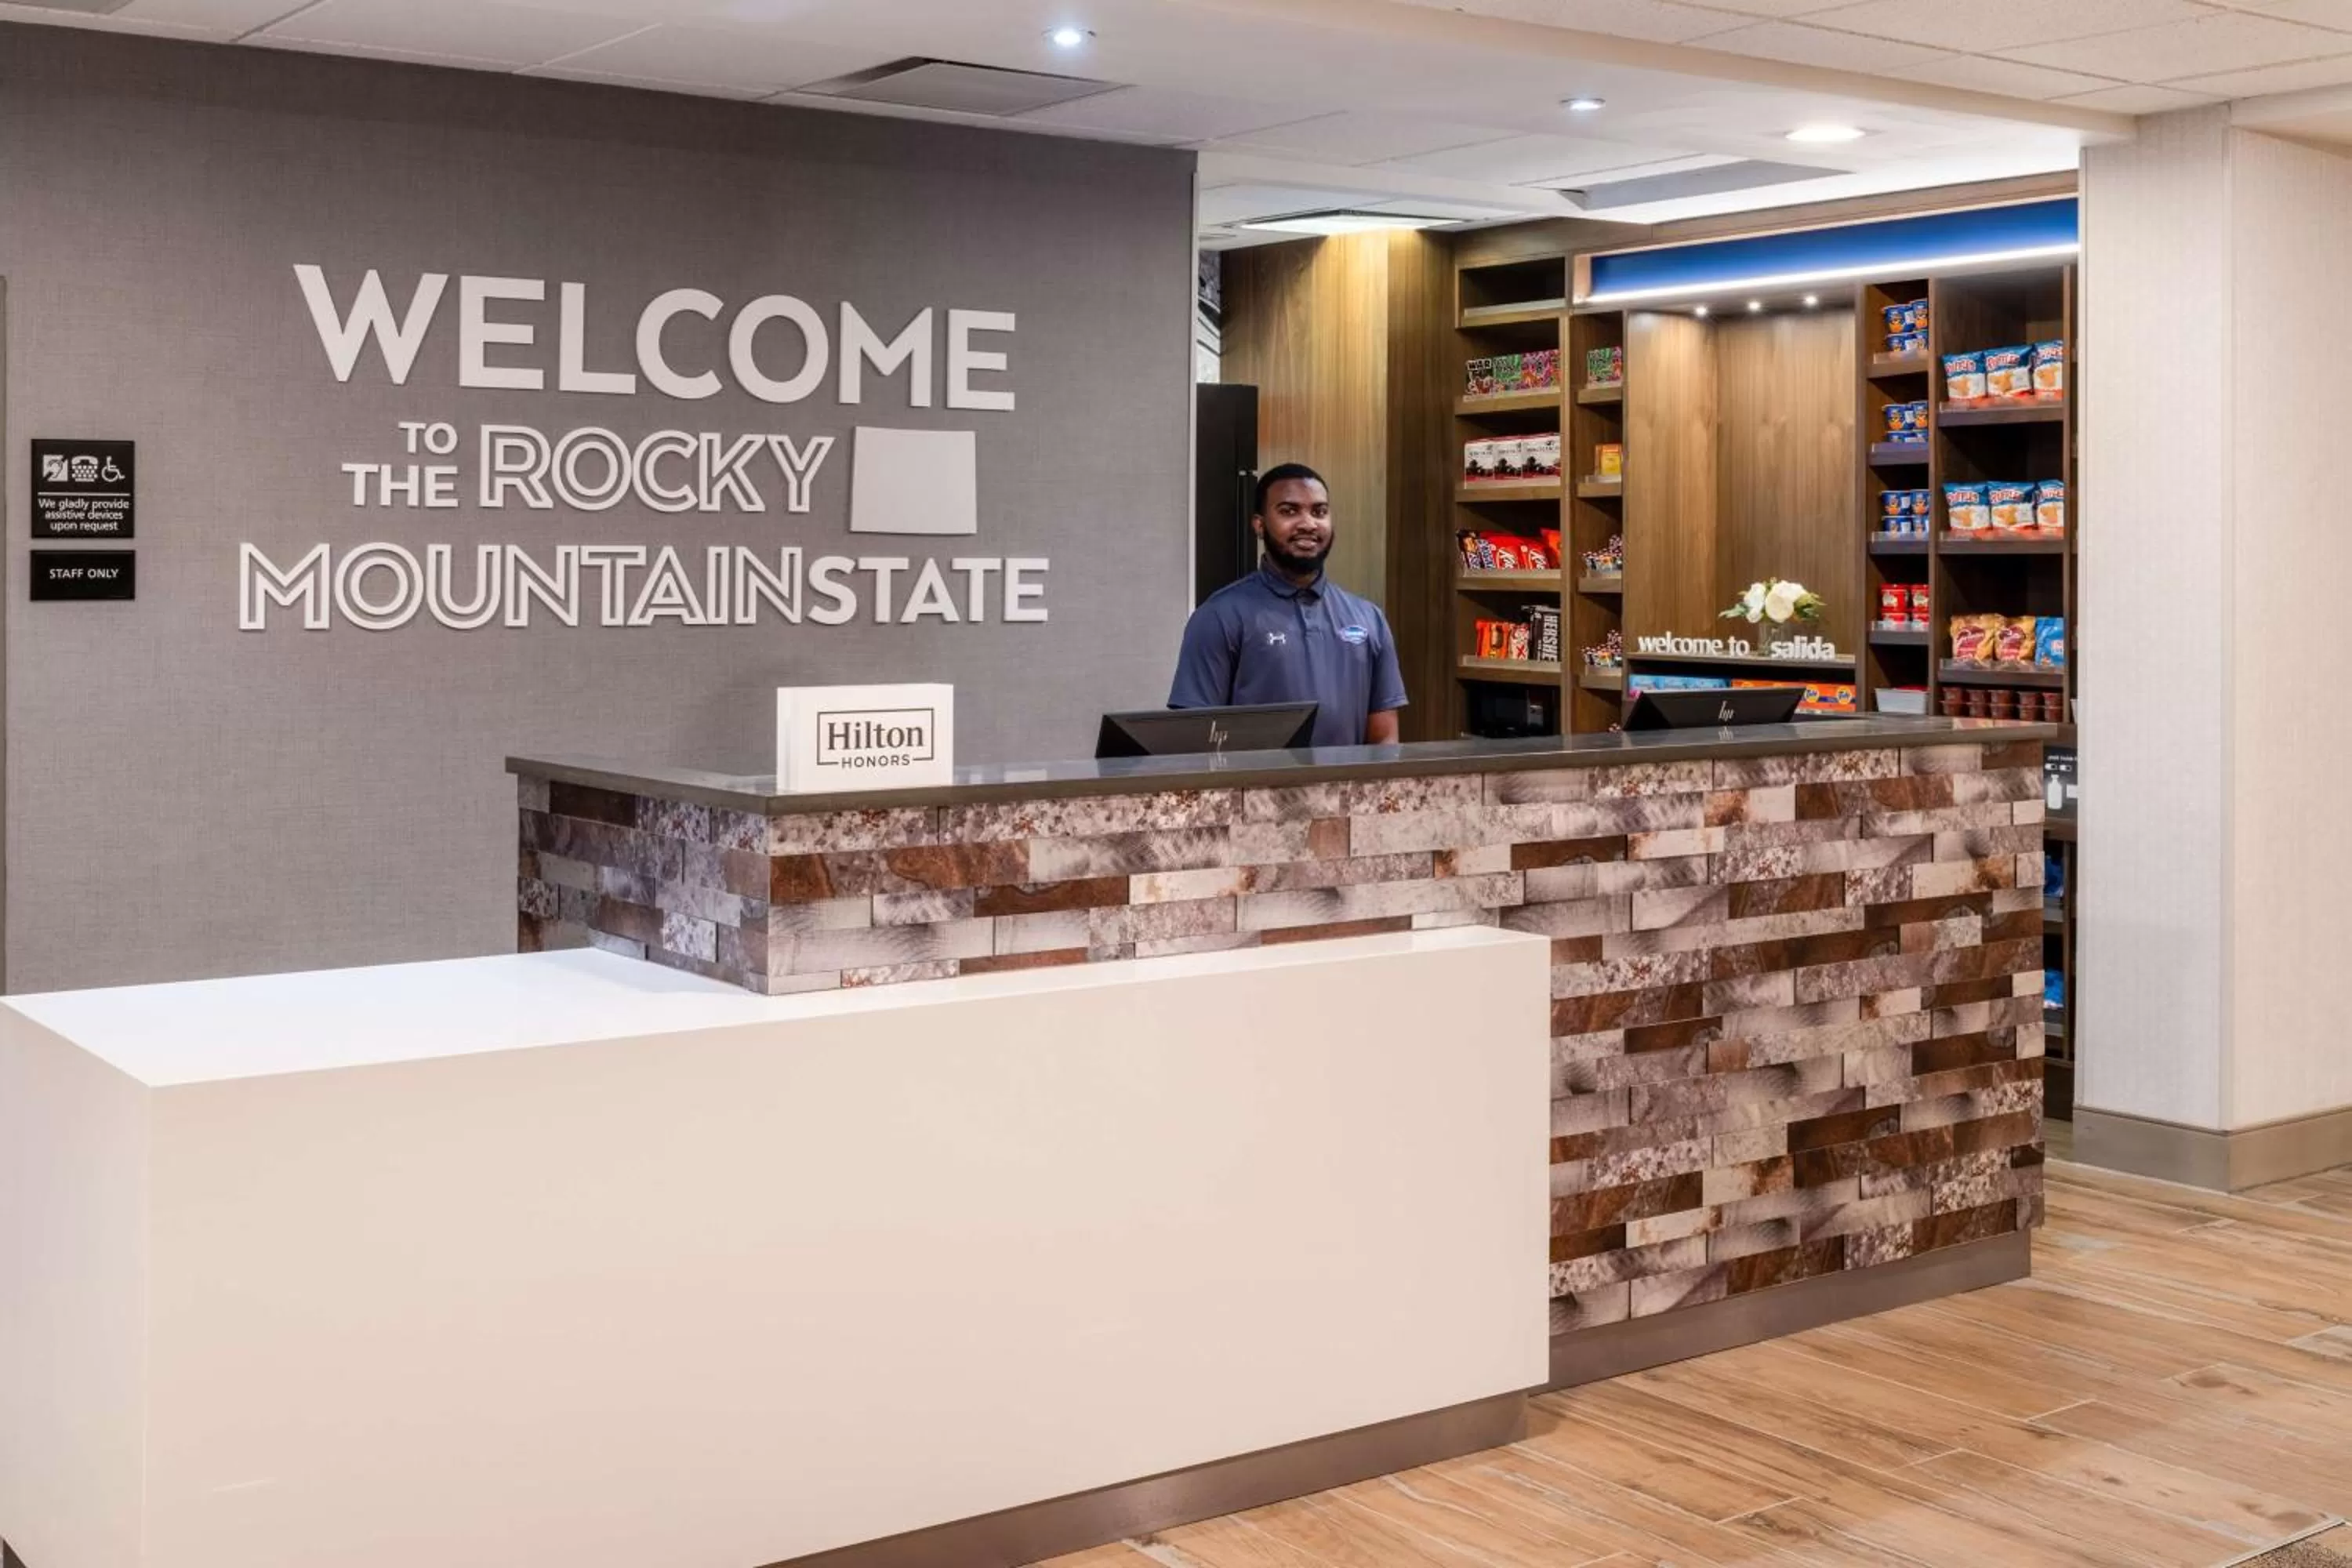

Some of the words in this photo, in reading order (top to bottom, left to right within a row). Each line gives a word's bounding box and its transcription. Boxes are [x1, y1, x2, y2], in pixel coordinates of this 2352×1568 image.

[292, 263, 1015, 412] WELCOME
[398, 421, 459, 454] TO
[341, 463, 459, 507] THE
[479, 423, 835, 513] ROCKY
[38, 499, 56, 508] We
[58, 498, 90, 510] gladly
[92, 499, 129, 510] provide
[45, 510, 85, 520] assistive
[87, 510, 124, 520] devices
[50, 522, 77, 531] upon
[79, 521, 118, 532] request
[49, 569, 84, 579] STAFF
[87, 569, 118, 579] ONLY
[1638, 630, 1723, 654] welcome
[1728, 636, 1750, 656] to
[1770, 635, 1835, 660] salida
[827, 720, 924, 750] Hilton
[841, 754, 910, 769] HONORS
